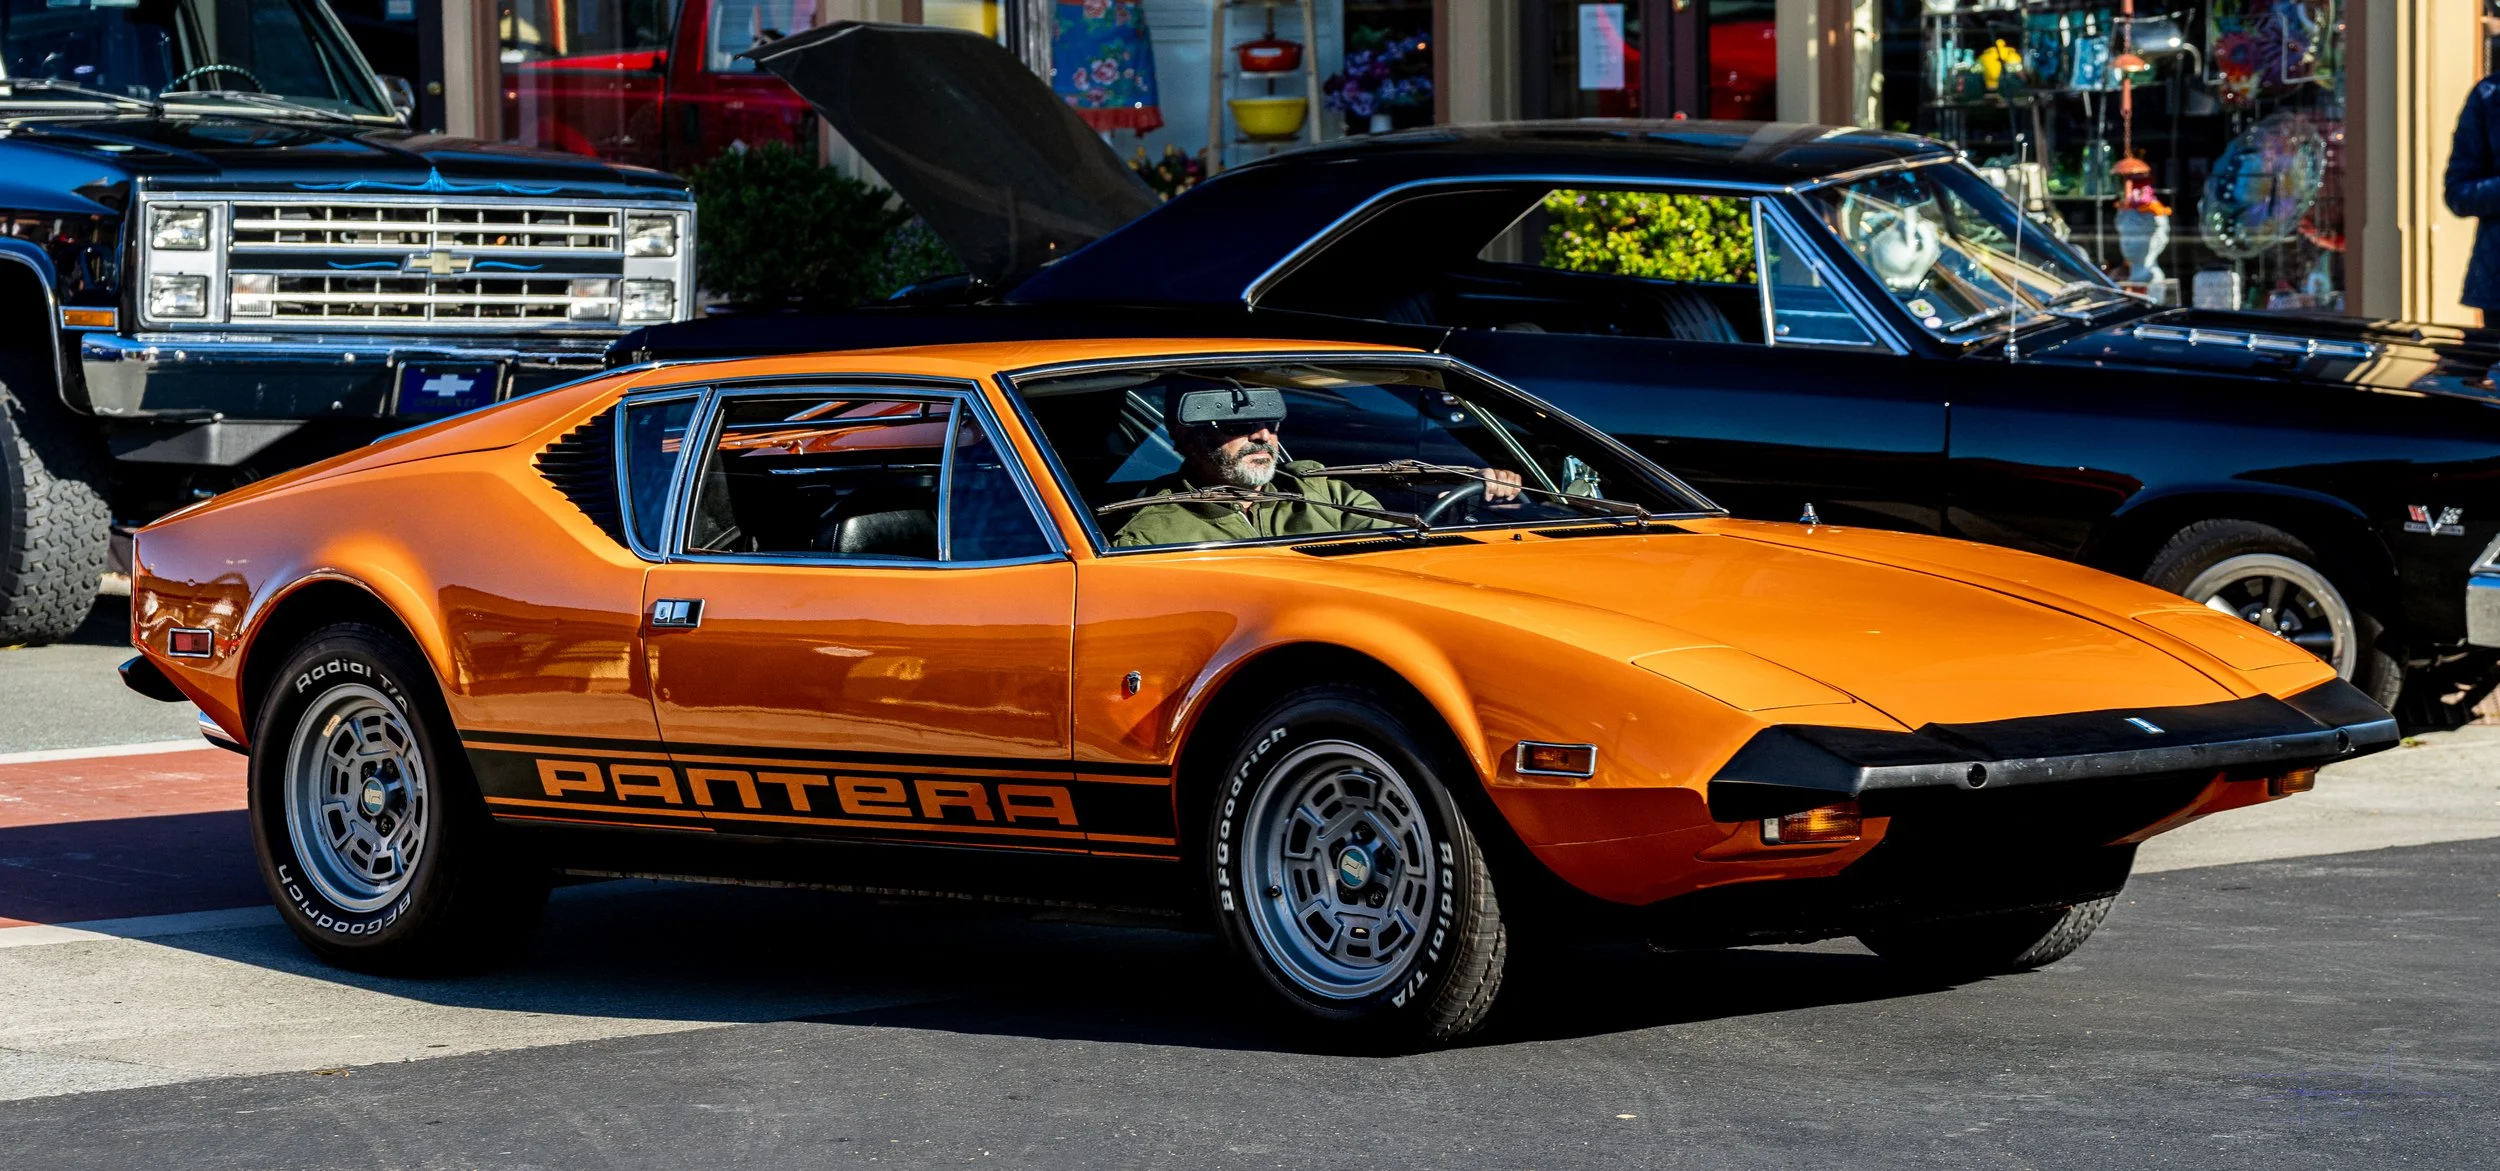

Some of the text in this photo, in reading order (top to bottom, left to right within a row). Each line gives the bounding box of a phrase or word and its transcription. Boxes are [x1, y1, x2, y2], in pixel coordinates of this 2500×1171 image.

[296, 659, 408, 714] Radial T/A
[536, 758, 1078, 825] PANTERA
[1217, 727, 1288, 912] BFGoodrich
[278, 864, 411, 936] BFGoodrich
[1393, 842, 1454, 1009] Radial T/A
